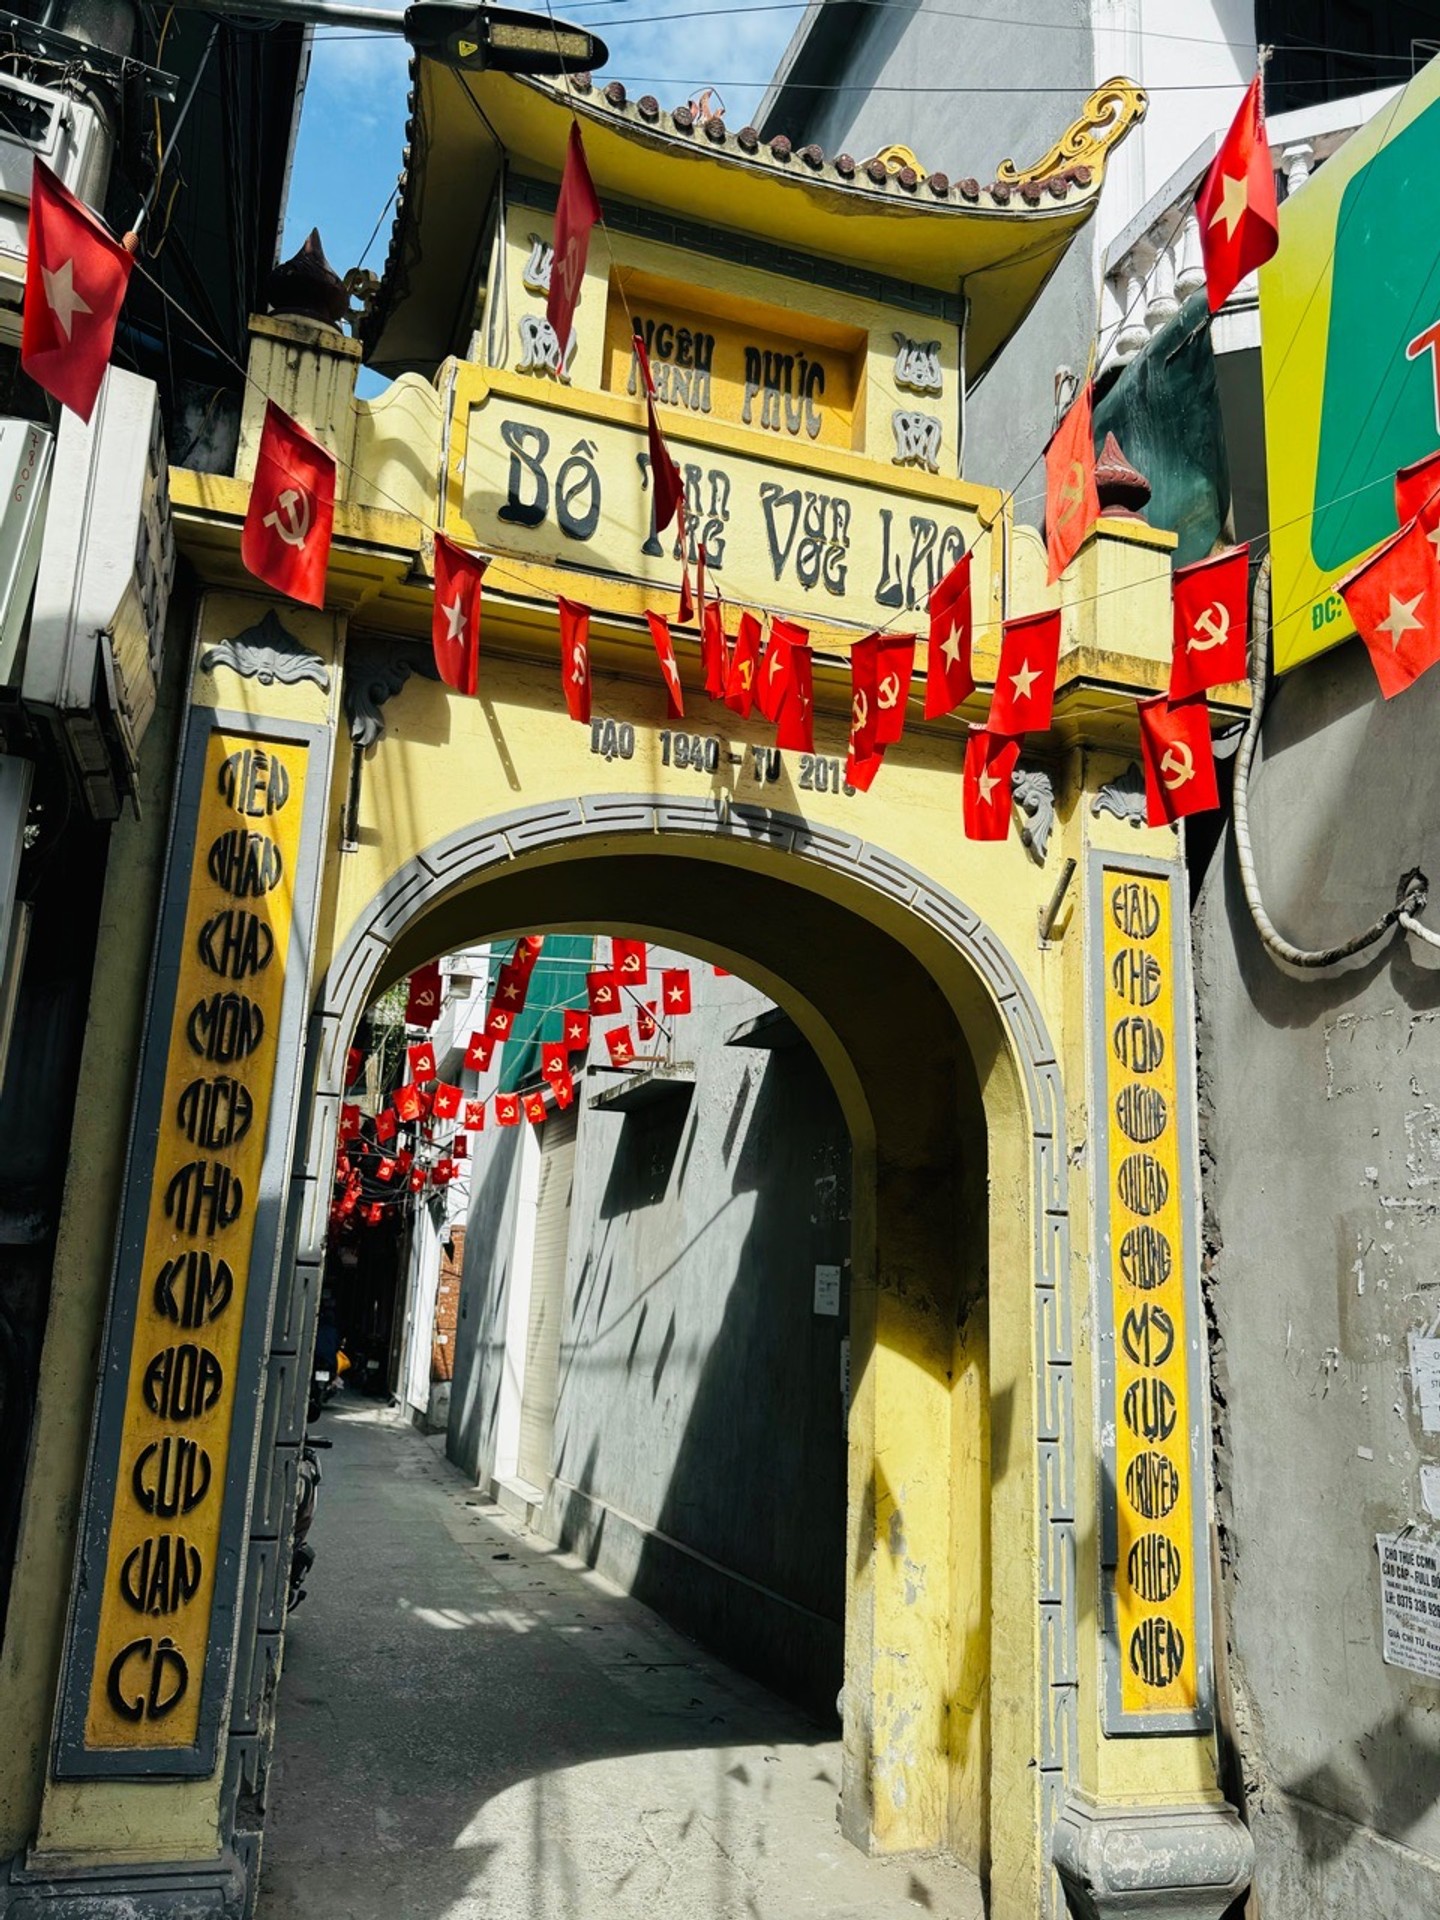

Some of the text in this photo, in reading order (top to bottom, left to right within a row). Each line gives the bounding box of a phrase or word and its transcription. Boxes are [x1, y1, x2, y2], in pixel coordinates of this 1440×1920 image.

[742, 346, 825, 440] PHÚC
[1311, 595, 1343, 631] ĐC:
[590, 716, 635, 763] TẠO
[659, 728, 721, 774] 1940
[798, 754, 857, 797] 201
[208, 829, 283, 897] NHÂN
[1112, 883, 1160, 940] HẬU
[186, 991, 264, 1063] MÔN
[154, 1251, 233, 1329] KIM
[1120, 1225, 1171, 1290] PHONG
[143, 1343, 223, 1422] HOA
[1123, 1377, 1177, 1444] TỤC
[1128, 1533, 1181, 1603] THIÊN
[1130, 1617, 1184, 1687] NIÊN
